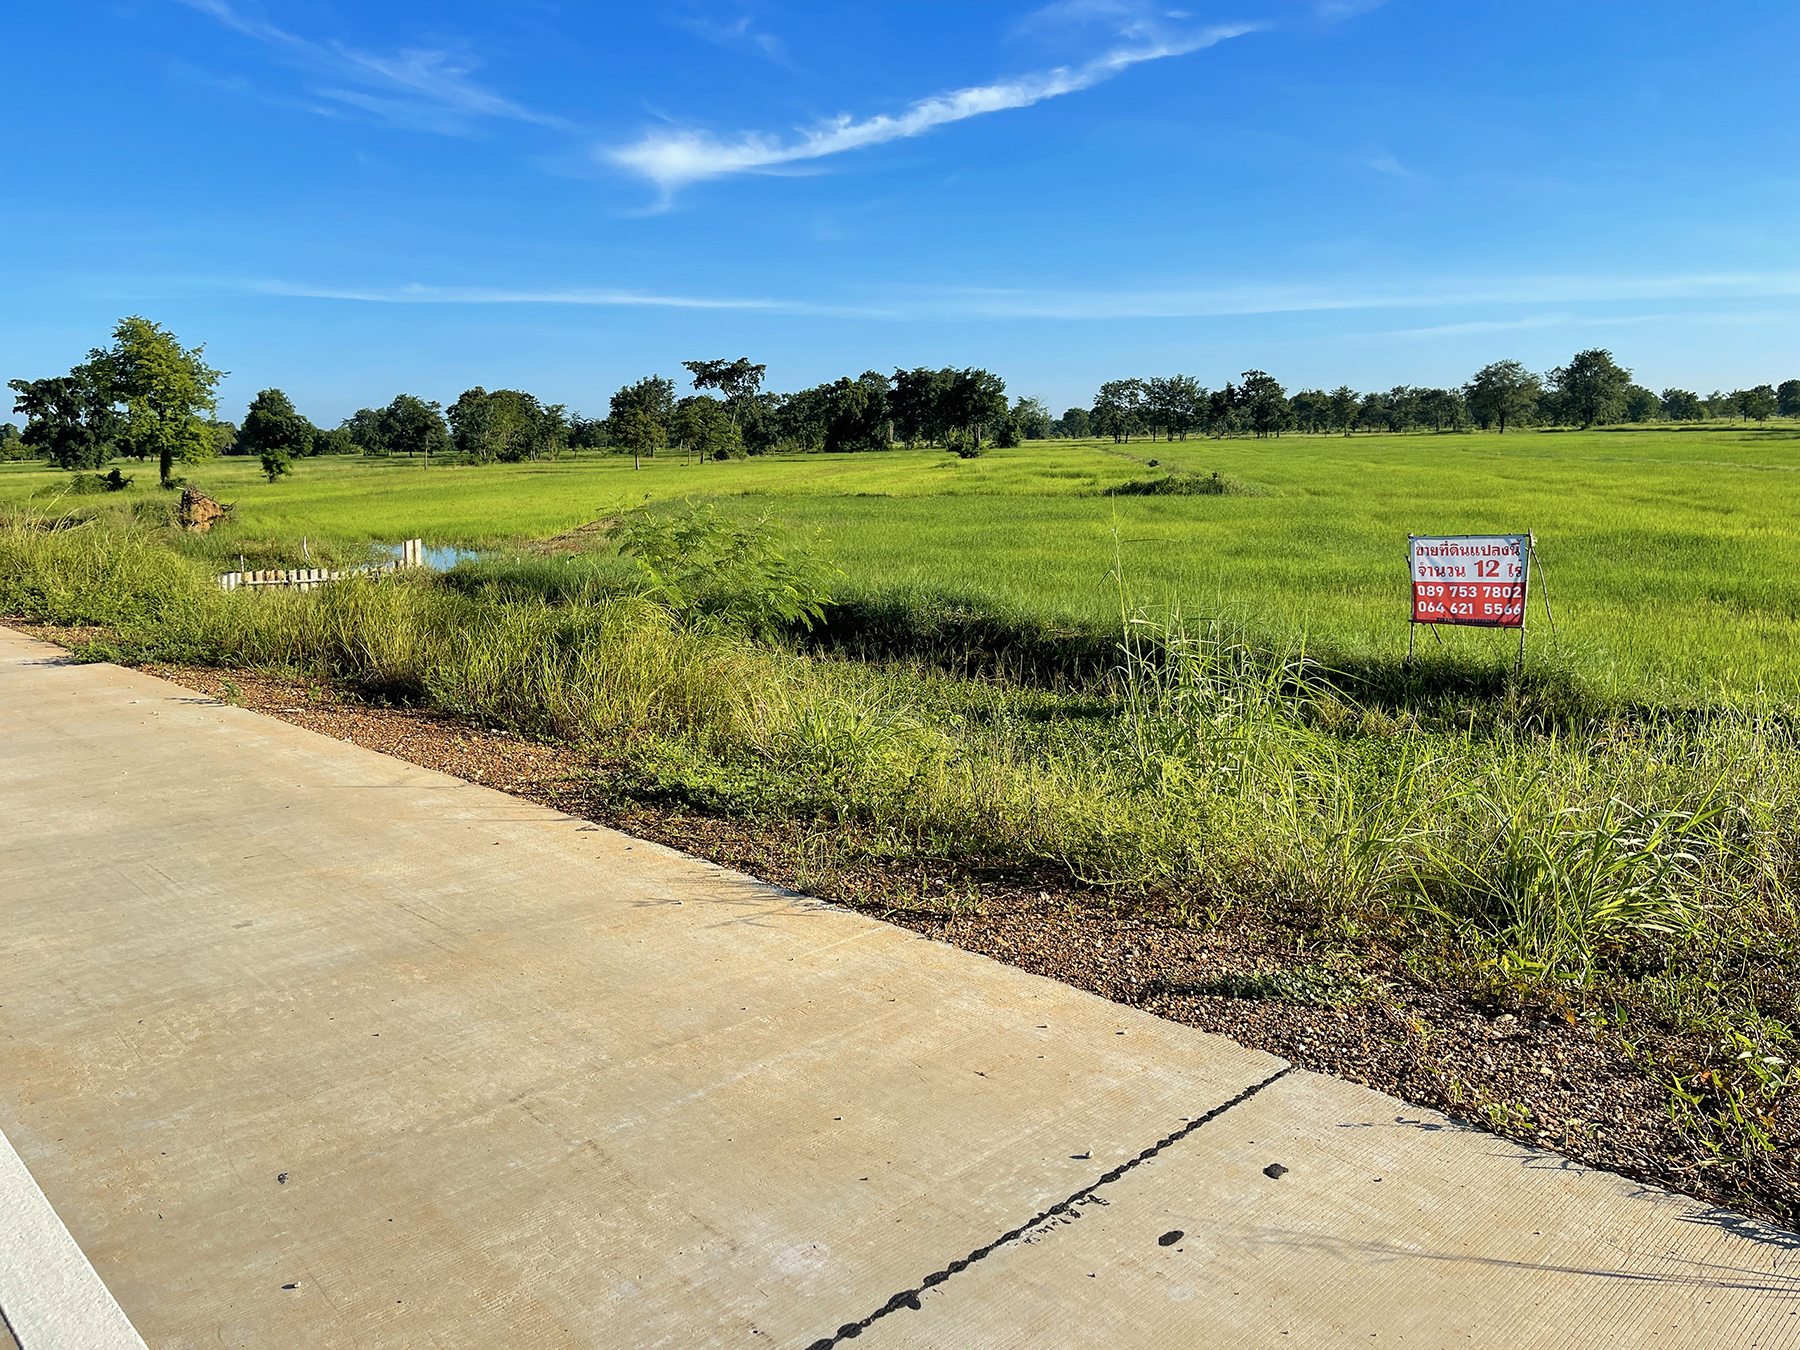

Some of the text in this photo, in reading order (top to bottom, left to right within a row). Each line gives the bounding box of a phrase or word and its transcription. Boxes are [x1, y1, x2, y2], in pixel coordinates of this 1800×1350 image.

[1416, 539, 1521, 556] ขายที่ดินแปลงนี้
[1418, 562, 1466, 577] จำนวน
[1474, 559, 1500, 577] 12
[1417, 585, 1521, 598] 089 753 7802
[1418, 601, 1521, 615] 064 621 5566
